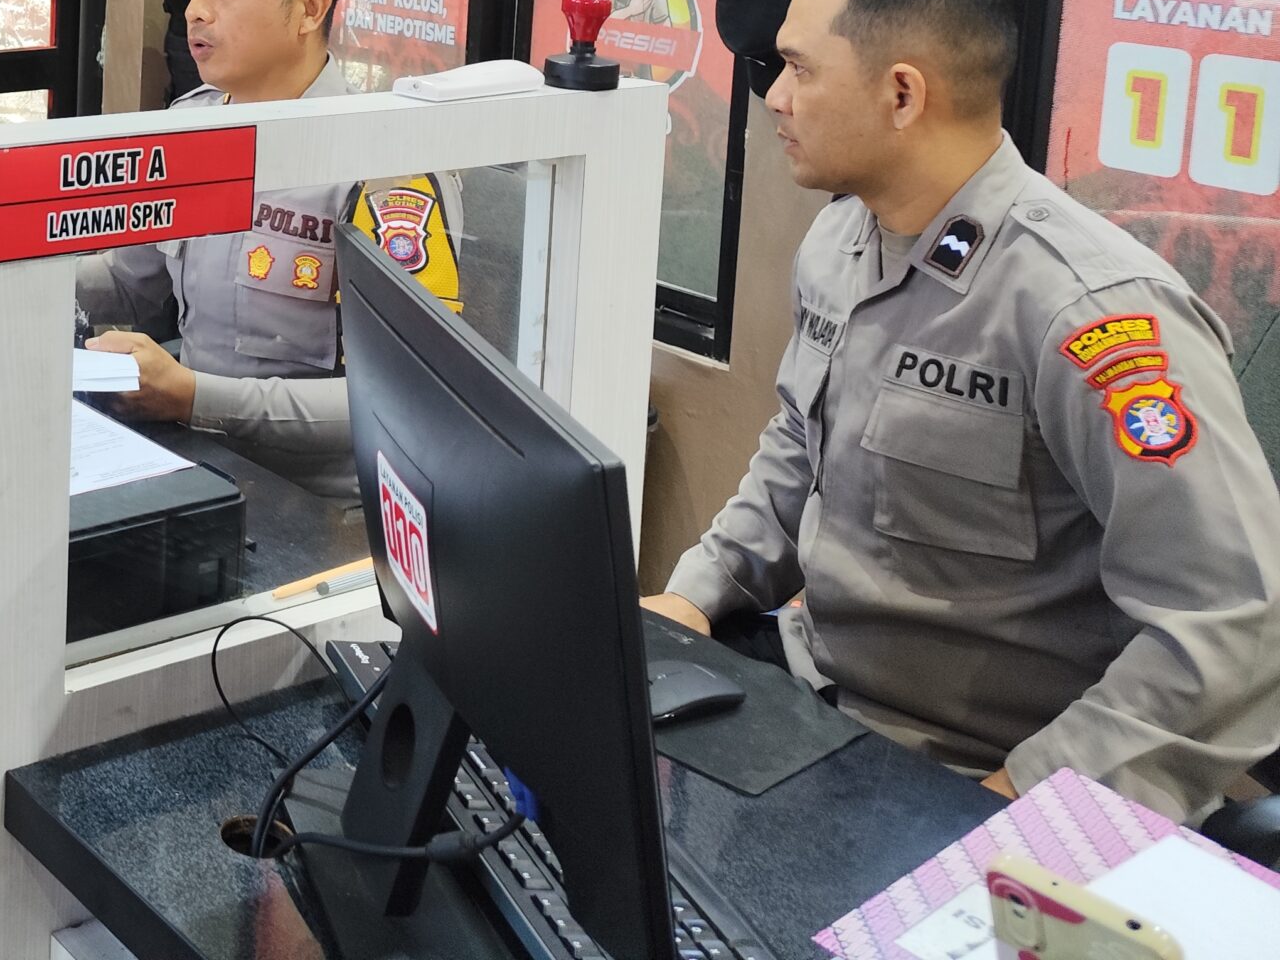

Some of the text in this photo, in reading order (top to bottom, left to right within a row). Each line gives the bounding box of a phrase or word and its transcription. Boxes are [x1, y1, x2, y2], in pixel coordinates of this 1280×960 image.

[346, 8, 456, 46] DAN NEPOTISME
[60, 146, 167, 191] LOKET A
[47, 200, 176, 242] LAYANAN SPKT
[254, 203, 334, 244] POLRI
[1069, 318, 1152, 355] POLRES
[894, 350, 1010, 408] POLRI
[381, 486, 428, 600] 110
